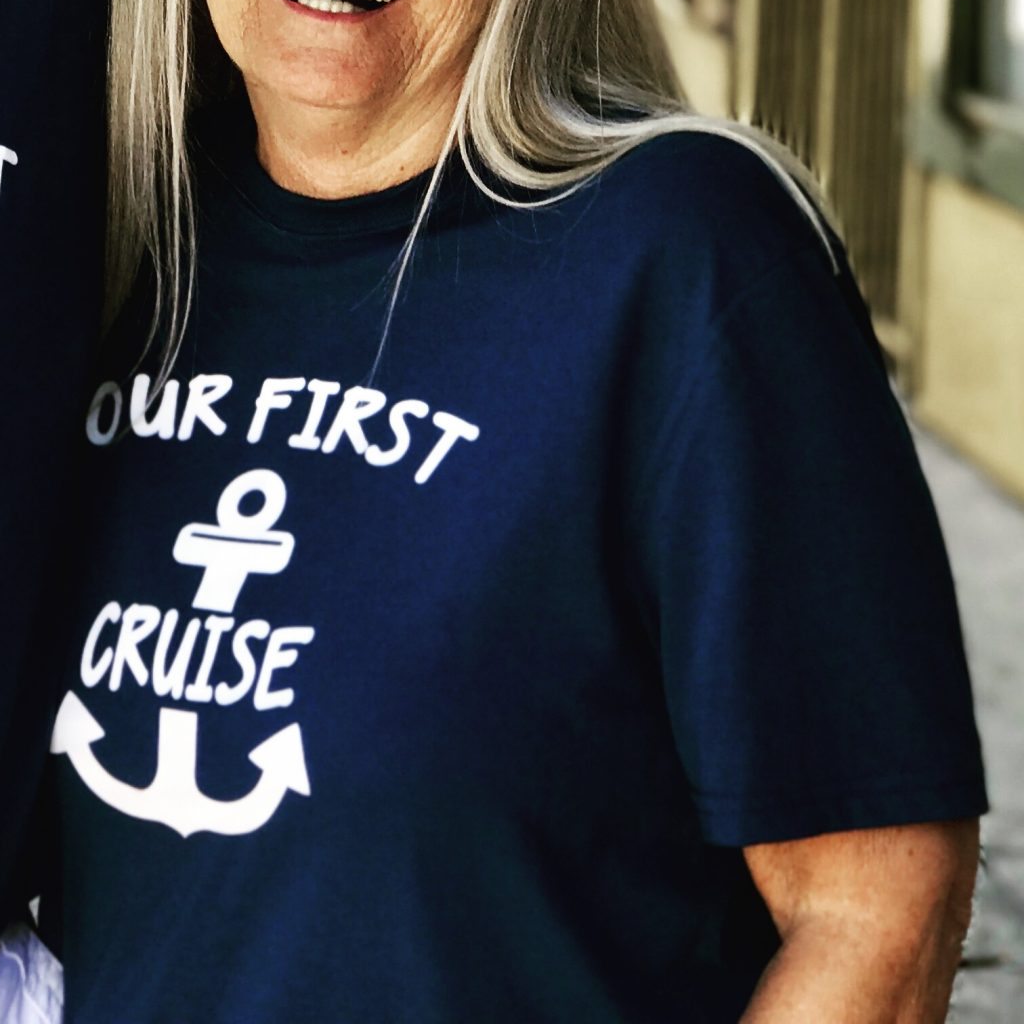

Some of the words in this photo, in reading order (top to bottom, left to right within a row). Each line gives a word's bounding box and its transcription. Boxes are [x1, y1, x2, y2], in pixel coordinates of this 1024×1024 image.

[85, 373, 233, 446] OUR
[246, 376, 480, 485] FIRST
[80, 601, 315, 711] CRUISE
